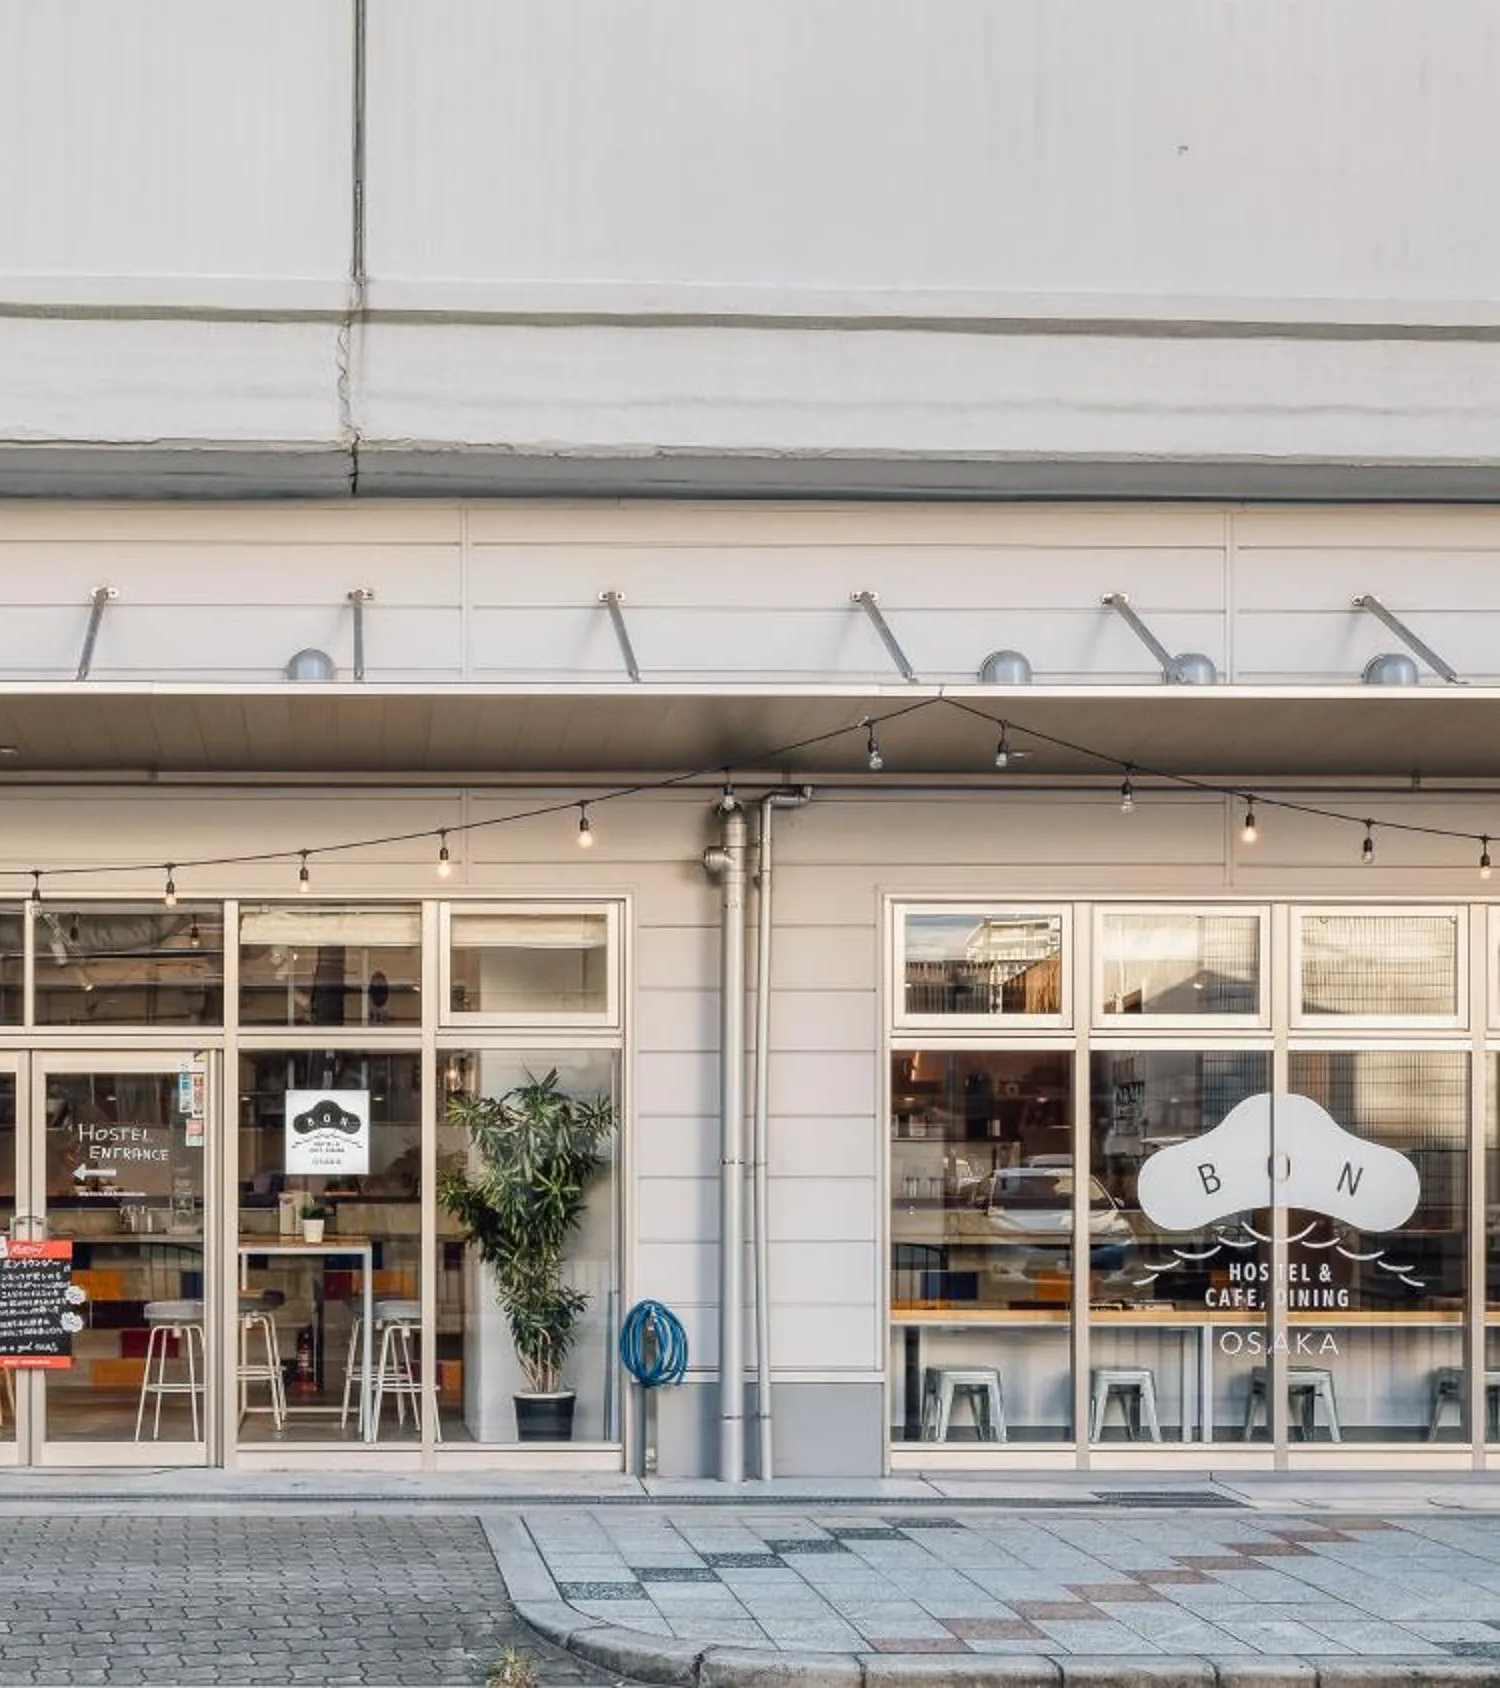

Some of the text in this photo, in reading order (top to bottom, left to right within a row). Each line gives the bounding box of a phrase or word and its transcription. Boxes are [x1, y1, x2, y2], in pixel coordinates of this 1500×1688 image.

[89, 1145, 170, 1161] ENTRANCE
[1197, 1151, 1364, 1198] BON
[1229, 1263, 1333, 1281] HOSTEL &
[1205, 1287, 1350, 1310] CAFE, DINING
[1219, 1331, 1340, 1355] OSAKA
